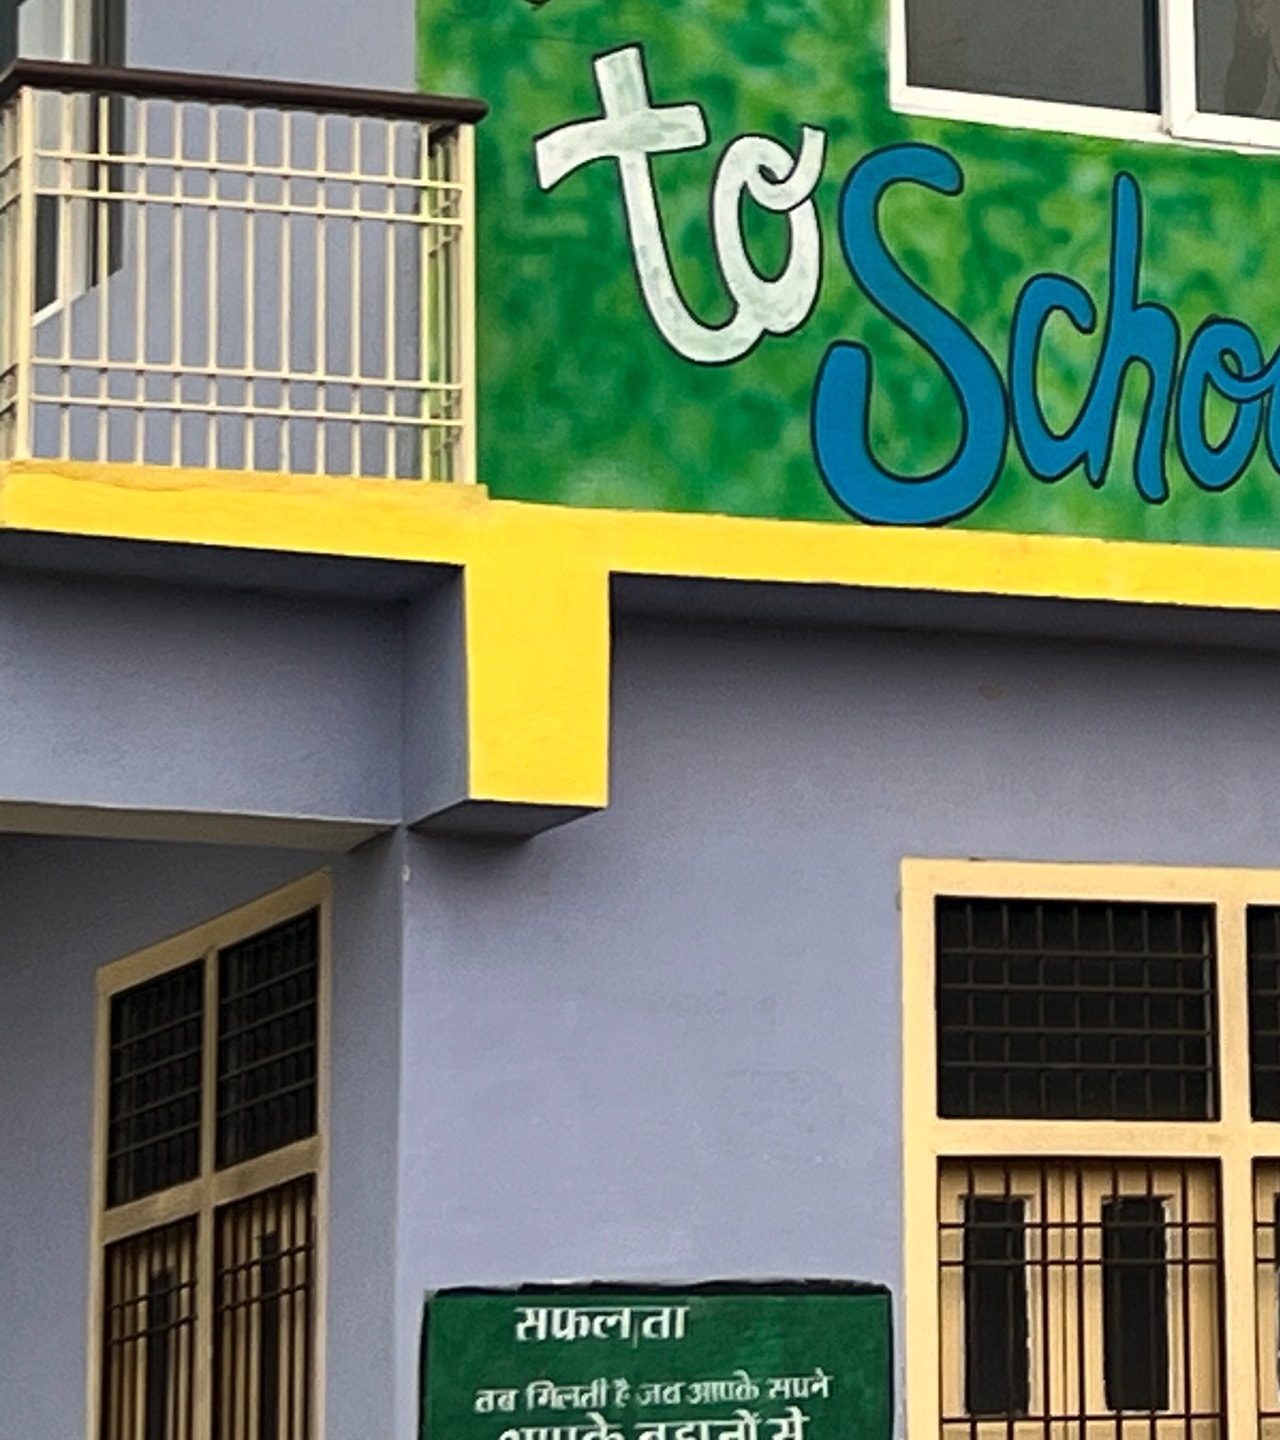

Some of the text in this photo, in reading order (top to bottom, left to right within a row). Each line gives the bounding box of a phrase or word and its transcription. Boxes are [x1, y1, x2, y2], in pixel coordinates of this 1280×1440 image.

[533, 41, 828, 366] to
[514, 1305, 690, 1342] सफलता
[474, 1388, 519, 1413] तब
[609, 1377, 631, 1409] है
[636, 1382, 686, 1406] जब
[687, 1369, 762, 1404] आपके
[767, 1367, 834, 1400] सपने
